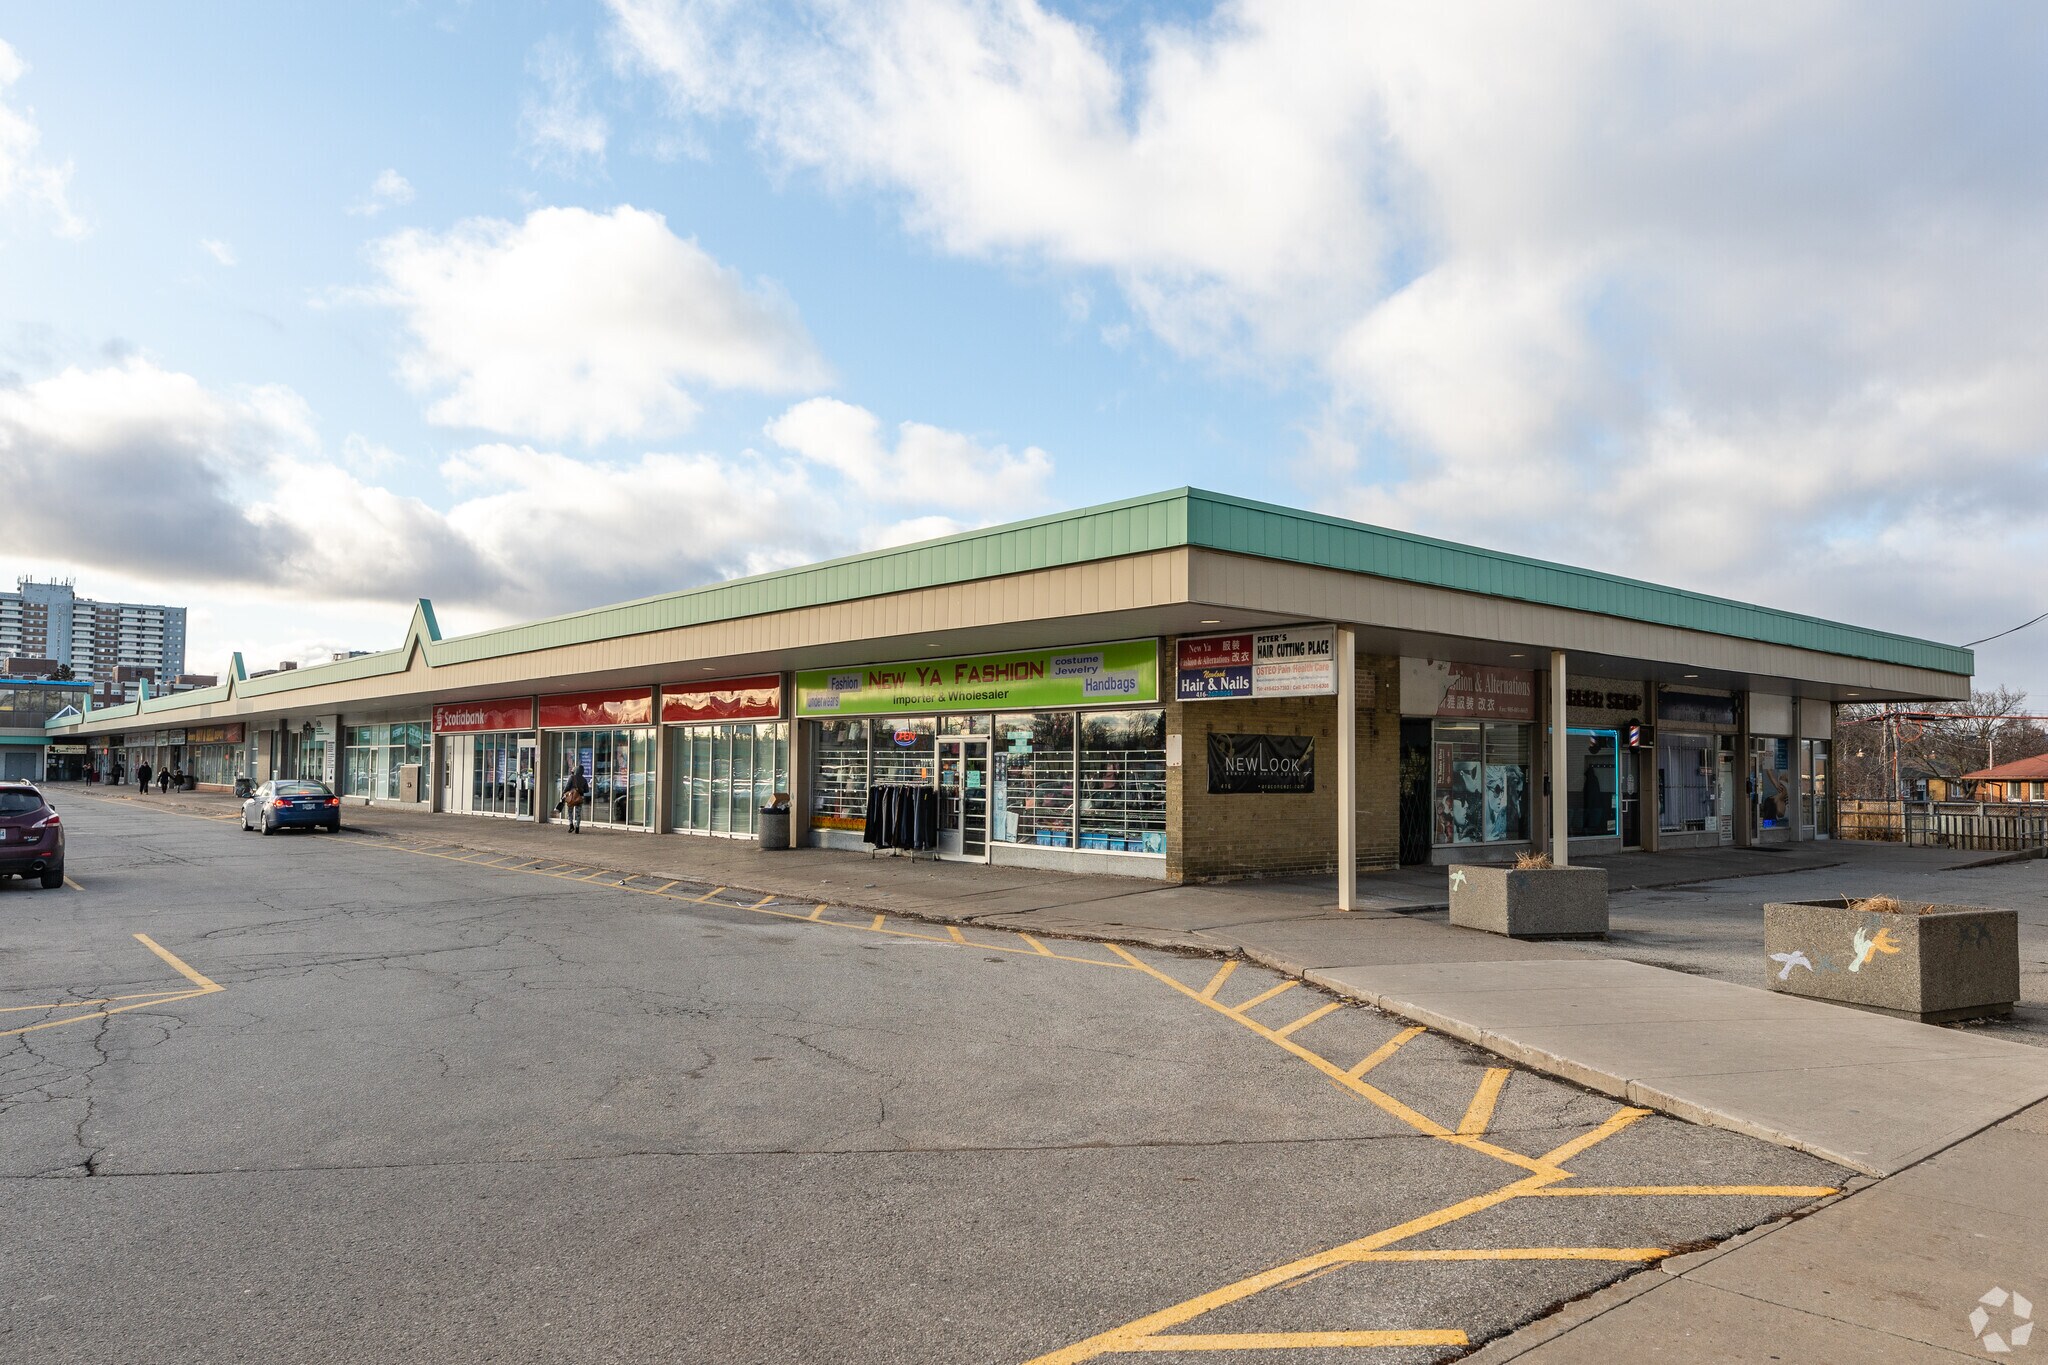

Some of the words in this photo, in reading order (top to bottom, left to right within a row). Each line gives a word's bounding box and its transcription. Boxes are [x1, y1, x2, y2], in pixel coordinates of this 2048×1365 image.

[1257, 633, 1287, 643] PETER'S
[1189, 644, 1201, 653] New
[1203, 643, 1212, 652] Ya
[1222, 640, 1240, 651] 服装
[1257, 644, 1274, 659] HAIR
[1276, 641, 1305, 657] CUTTING
[1308, 640, 1329, 655] PLACE
[1055, 656, 1099, 665] costume
[1231, 651, 1250, 662] 改衣
[868, 671, 907, 689] NEW
[916, 667, 942, 686] YA
[955, 660, 1044, 684] FASHION
[1055, 665, 1098, 675] Jewelry
[1256, 666, 1277, 675] OSTEO
[1314, 662, 1329, 671] Care
[831, 676, 858, 690] Fashion
[1085, 676, 1136, 693] Handbags
[1181, 678, 1205, 692] Hair
[1207, 677, 1218, 691] &
[1220, 675, 1250, 690] Nails
[1474, 672, 1482, 692] &
[1485, 673, 1531, 696] Alternations
[893, 694, 935, 706] Importer
[938, 693, 945, 702] &
[948, 689, 1009, 702] Wholesaler
[444, 708, 485, 726] Scotiabank
[895, 731, 916, 741] OPEN
